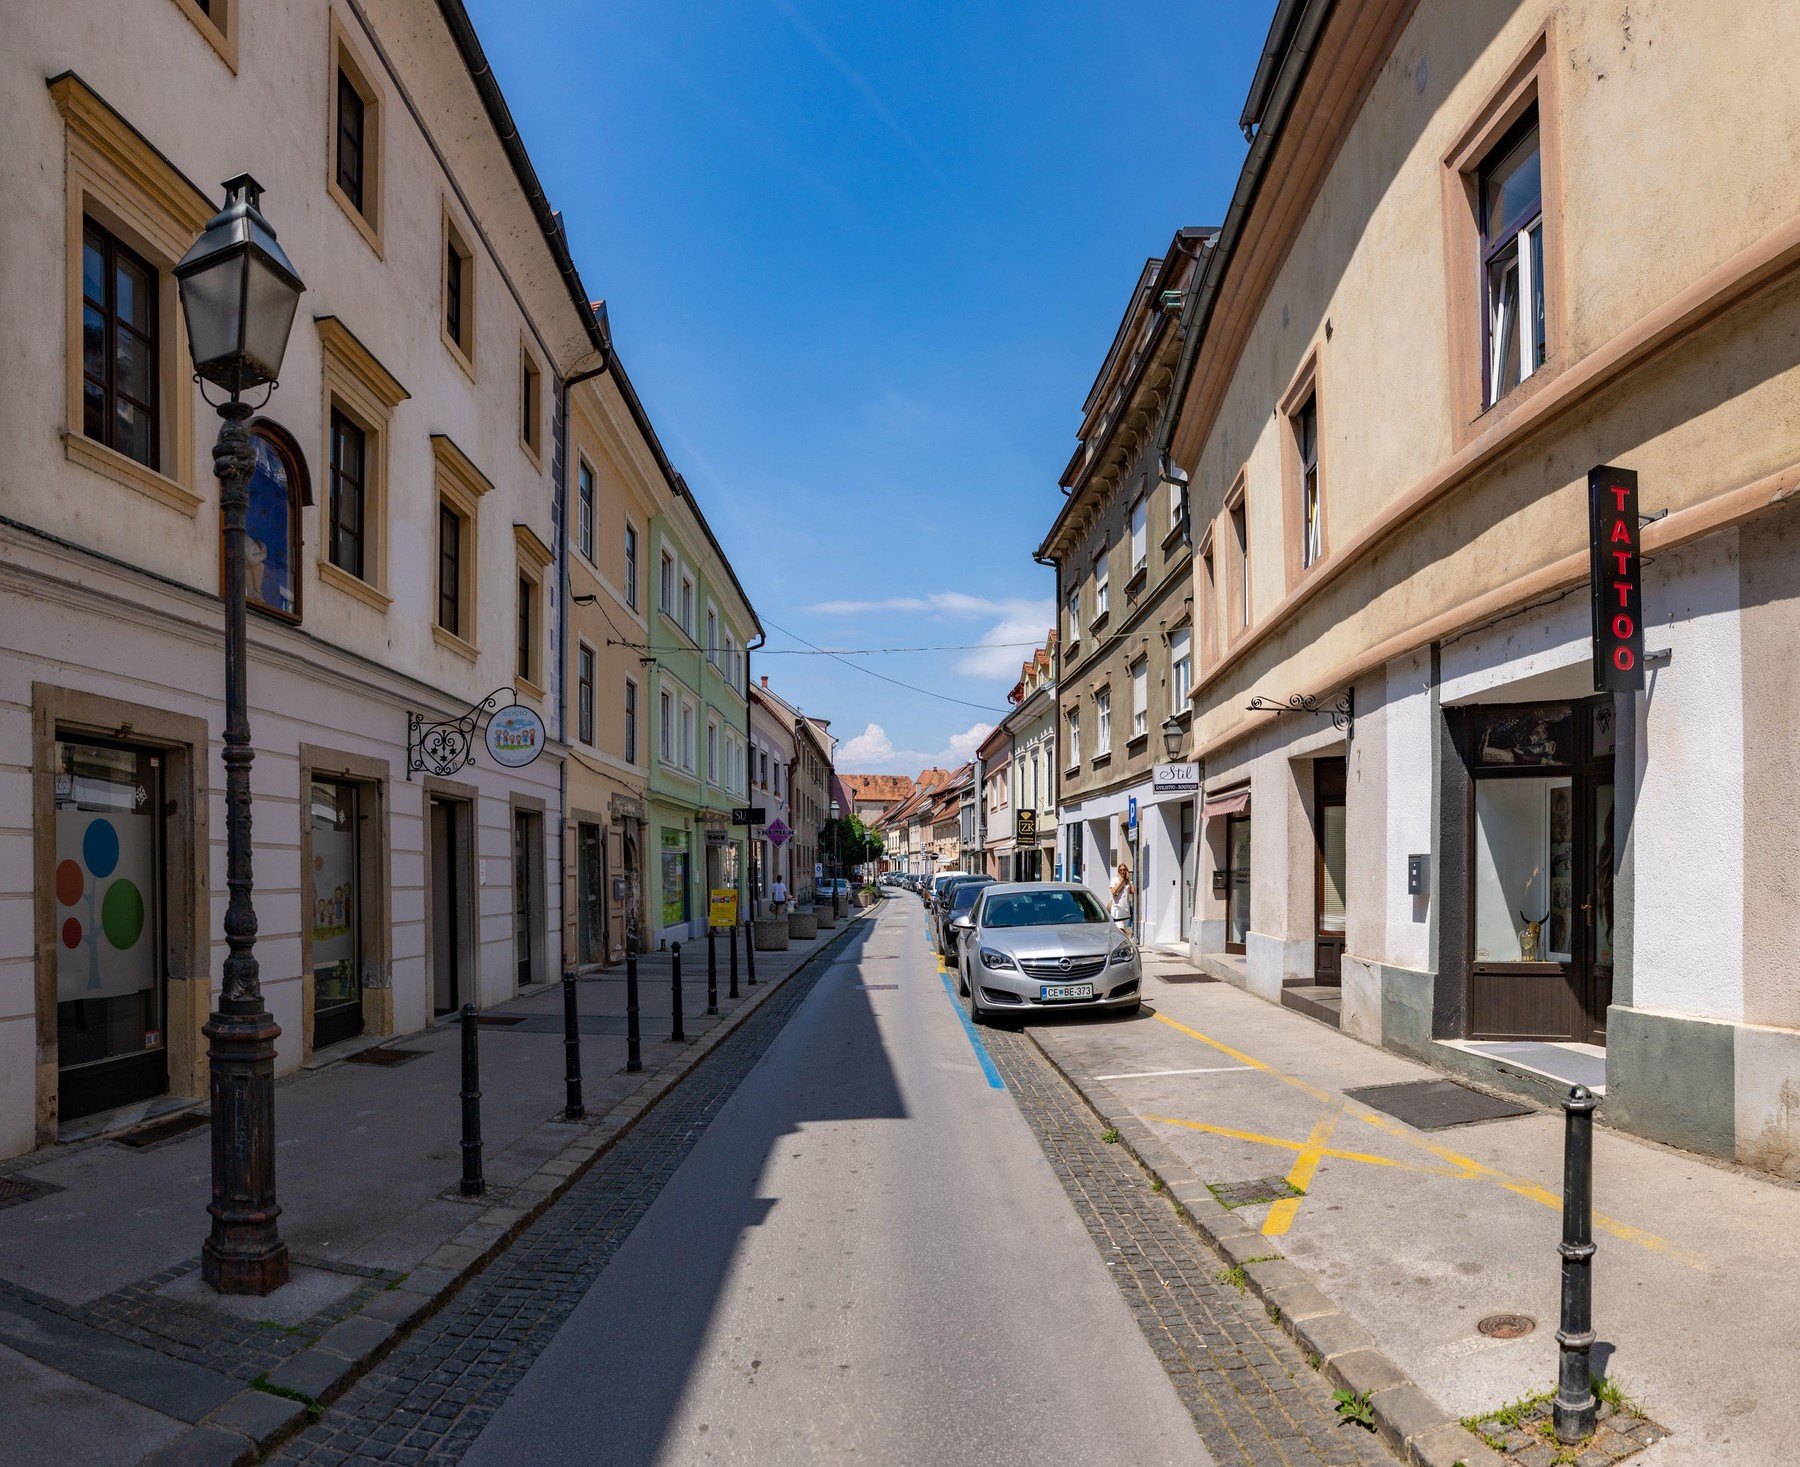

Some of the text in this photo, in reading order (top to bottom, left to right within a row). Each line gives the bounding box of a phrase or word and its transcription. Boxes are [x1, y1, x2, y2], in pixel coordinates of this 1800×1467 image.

[1610, 485, 1634, 671] TATTOO
[1159, 764, 1193, 780] Stil
[1130, 803, 1135, 823] P
[1021, 823, 1035, 832] ZK
[1048, 986, 1091, 997] CE BE-373
